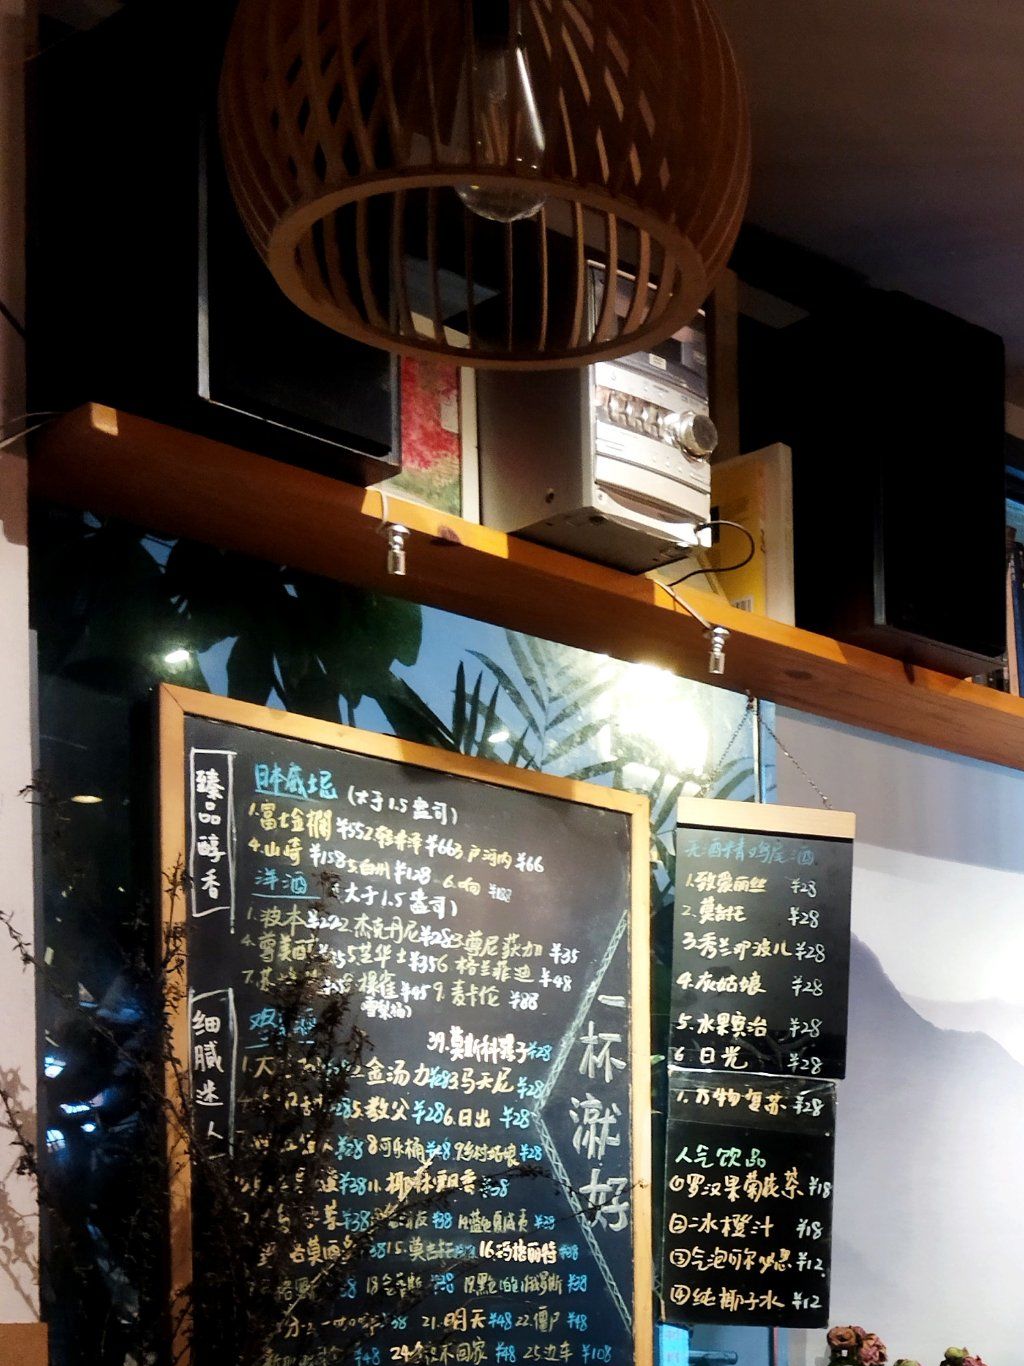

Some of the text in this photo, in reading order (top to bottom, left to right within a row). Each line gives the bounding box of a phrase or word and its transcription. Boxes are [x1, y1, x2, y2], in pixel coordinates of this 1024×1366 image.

[195, 767, 227, 900] 臻品醇香
[255, 867, 308, 895] 洋酒
[787, 906, 820, 929] ¥28
[795, 941, 826, 963] ¥28
[791, 975, 824, 997] ¥28
[789, 1017, 823, 1038] ¥28
[786, 1052, 823, 1075] ¥28
[411, 1099, 445, 1126] ¥28
[499, 1103, 531, 1130] ¥28
[792, 1095, 825, 1117] ¥28
[675, 1144, 767, 1169] 人气饮品
[808, 1175, 832, 1199] ¥18
[796, 1218, 824, 1240] ¥18
[796, 1251, 824, 1272] ¥12
[792, 1291, 823, 1311] ¥12
